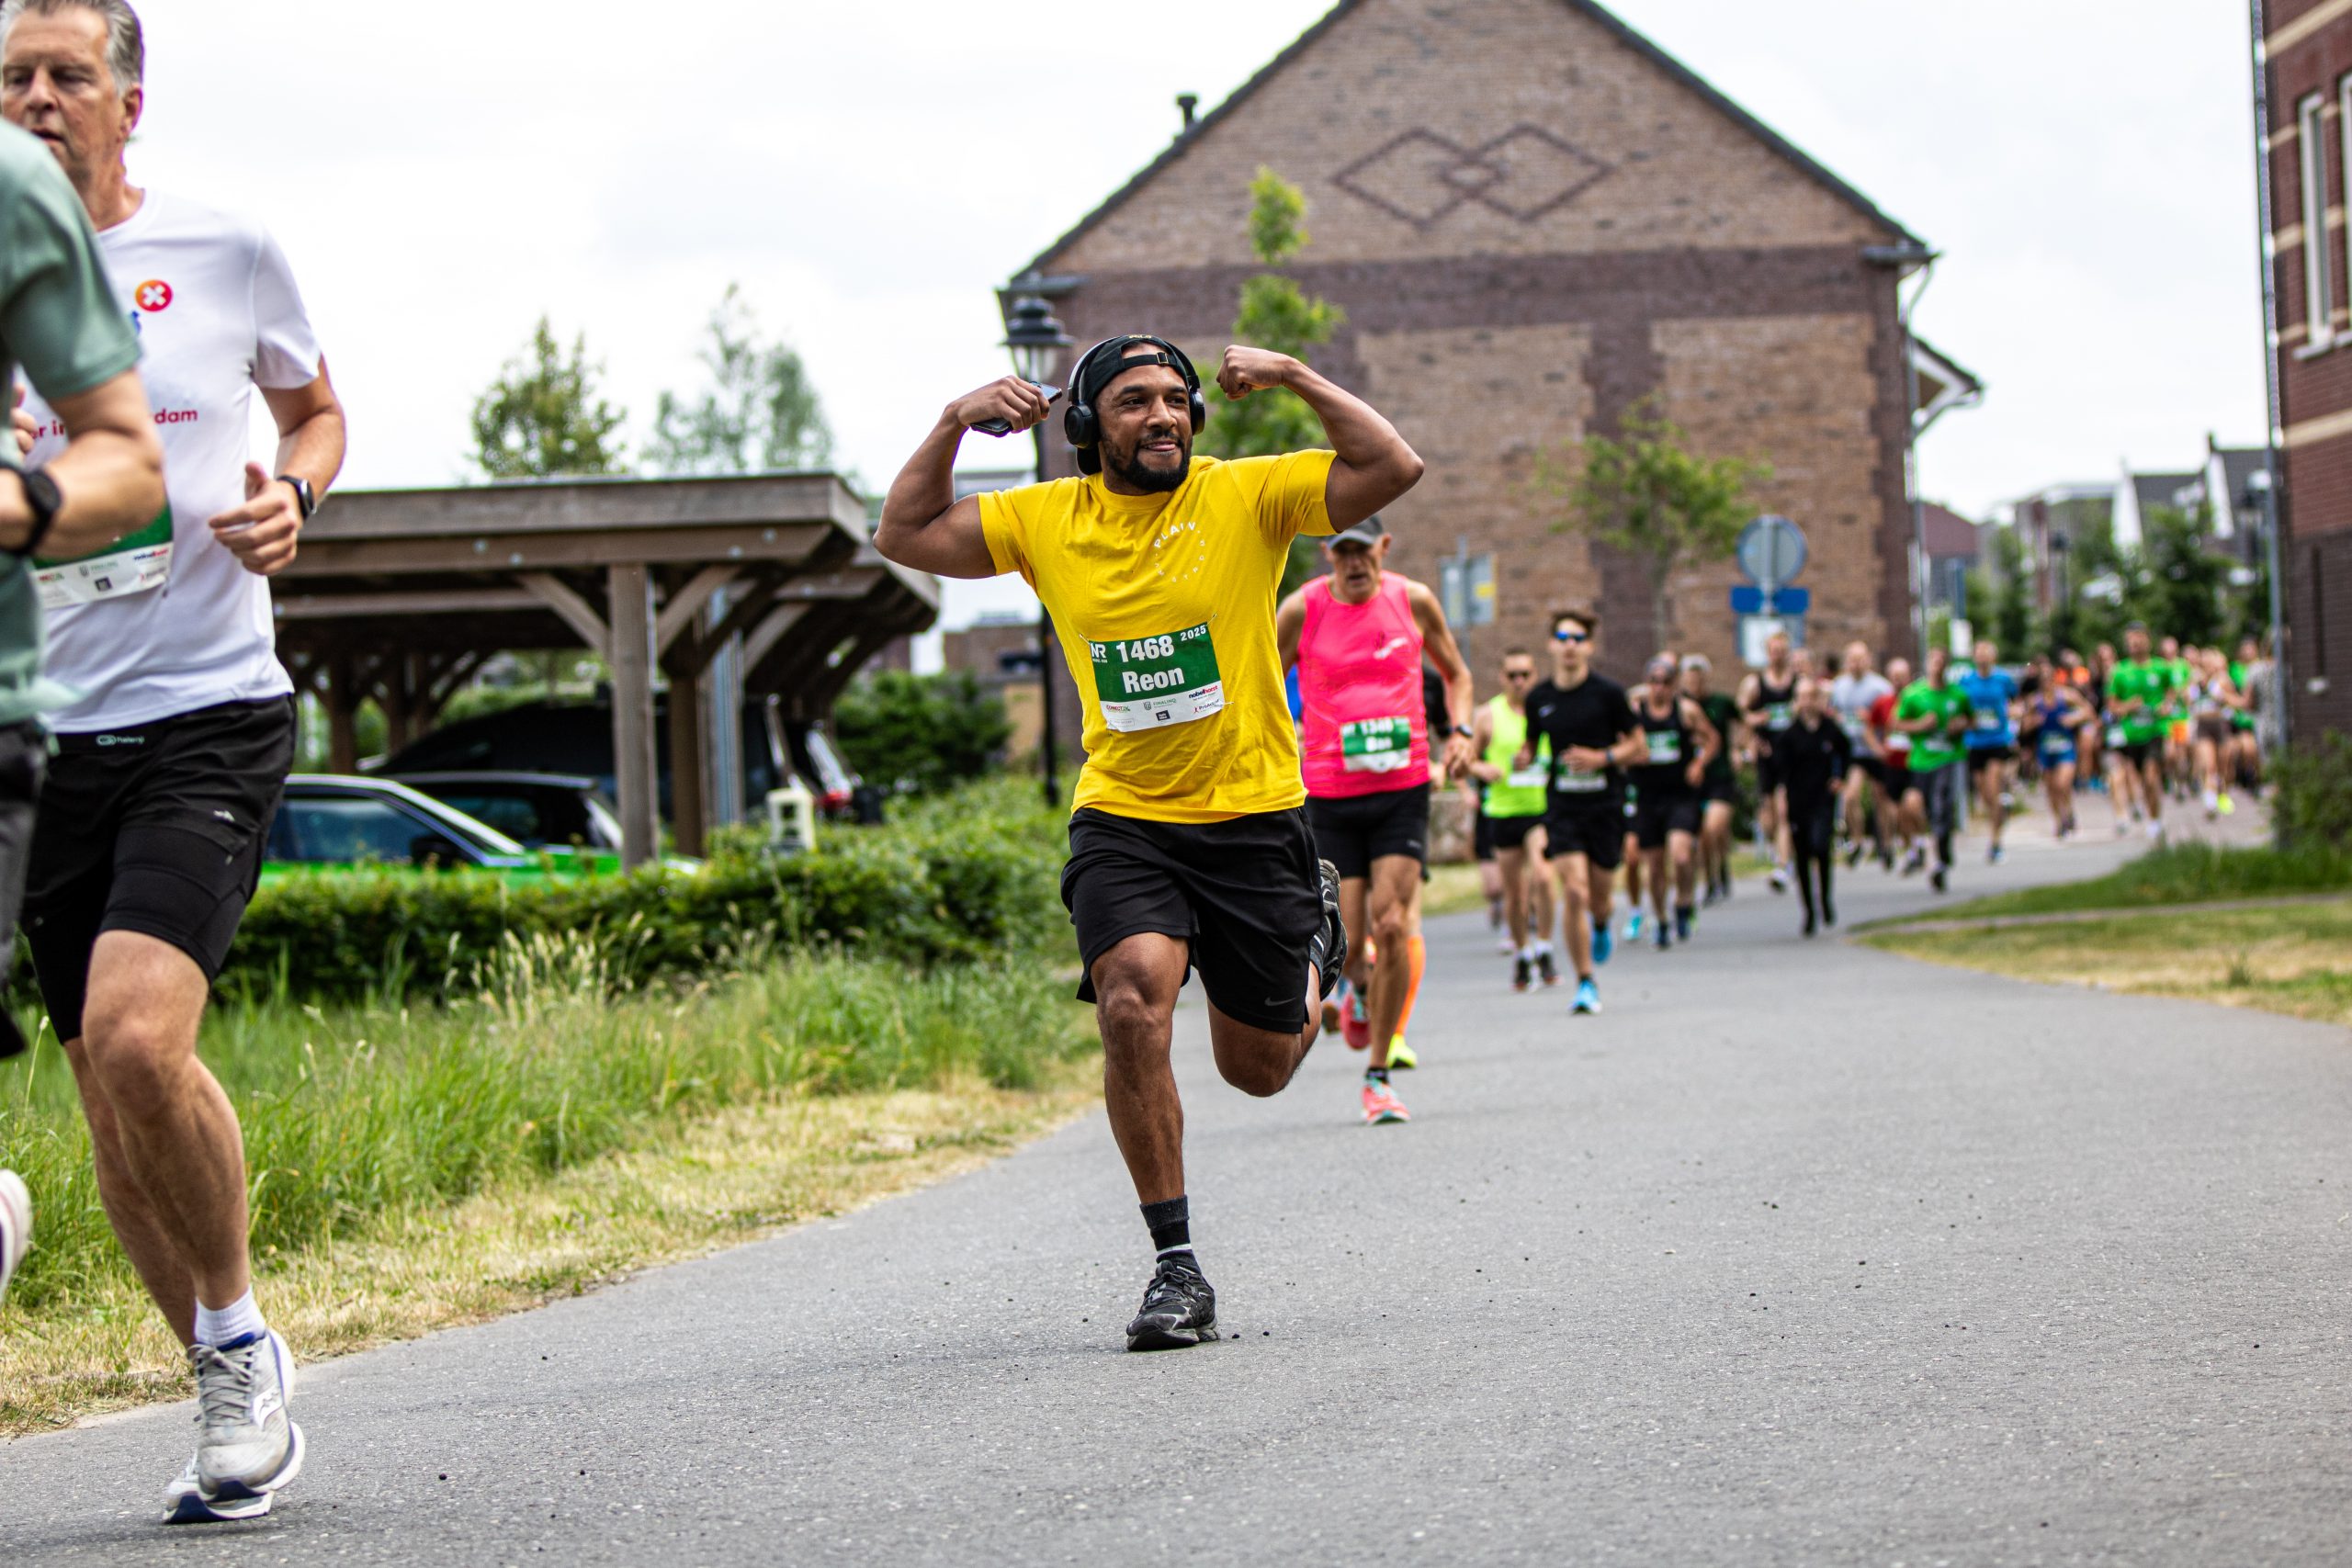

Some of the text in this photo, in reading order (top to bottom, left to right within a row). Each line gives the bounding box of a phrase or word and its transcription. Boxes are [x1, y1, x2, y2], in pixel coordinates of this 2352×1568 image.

[1116, 636, 1175, 662] 1468
[1181, 625, 1206, 641] 2025
[1122, 667, 1185, 694] Reon
